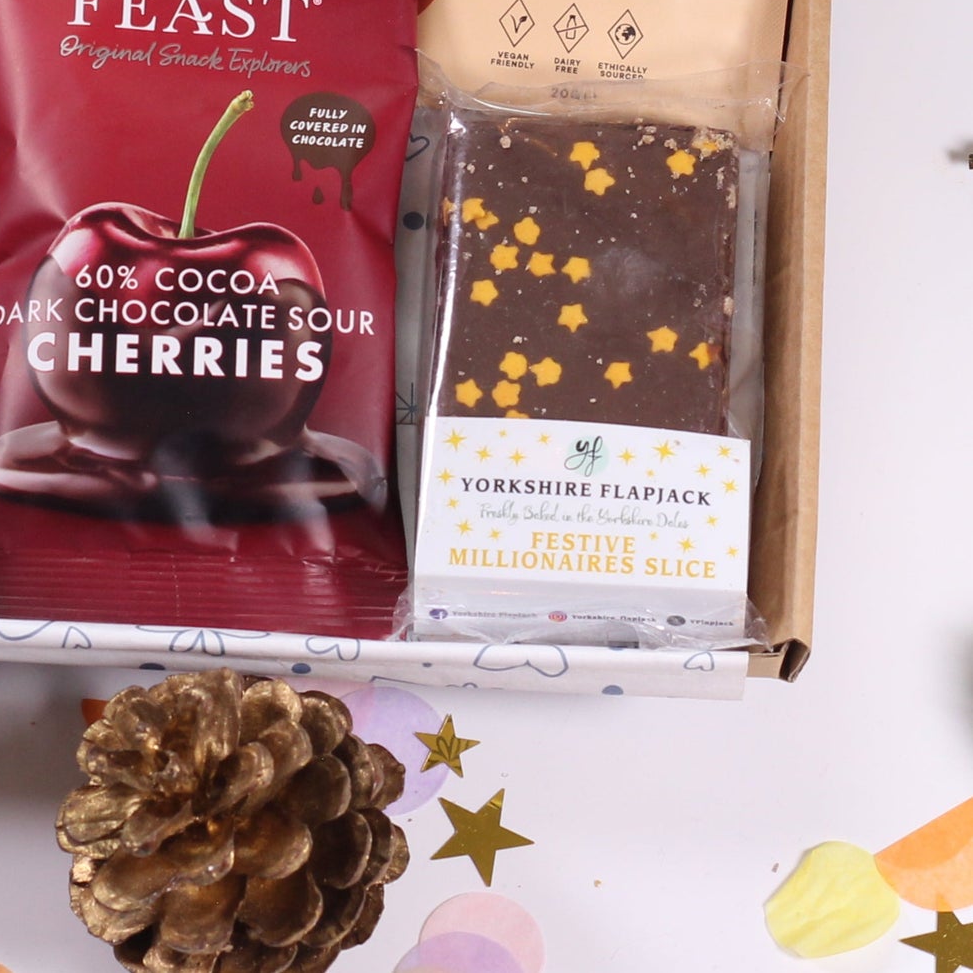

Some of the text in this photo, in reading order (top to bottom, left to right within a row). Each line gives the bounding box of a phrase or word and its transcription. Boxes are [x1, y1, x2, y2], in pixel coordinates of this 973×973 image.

[60, 34, 311, 78] Original Snack Explorers
[491, 59, 535, 69] FRIENDLY
[498, 51, 529, 61] VEGAN
[554, 57, 581, 66] DAIRY
[555, 66, 578, 74] FREE
[598, 62, 647, 73] ETHICALLY
[309, 107, 347, 119] FULLY
[289, 120, 366, 133] COVERED IN
[292, 135, 364, 148] CHOCOLATE
[75, 265, 280, 296] 60% COCOA
[74, 300, 276, 330] CHOCOLATE
[288, 307, 375, 336] SOUR
[27, 331, 324, 381] CHERRIES
[461, 477, 711, 506] YORKSHIRE FLAPJACK
[479, 500, 519, 524] Freshly
[523, 502, 559, 520] Baked
[577, 507, 594, 523] the
[531, 531, 636, 554] FESTIVE
[448, 548, 716, 579] MILLIONAIRES SLICE
